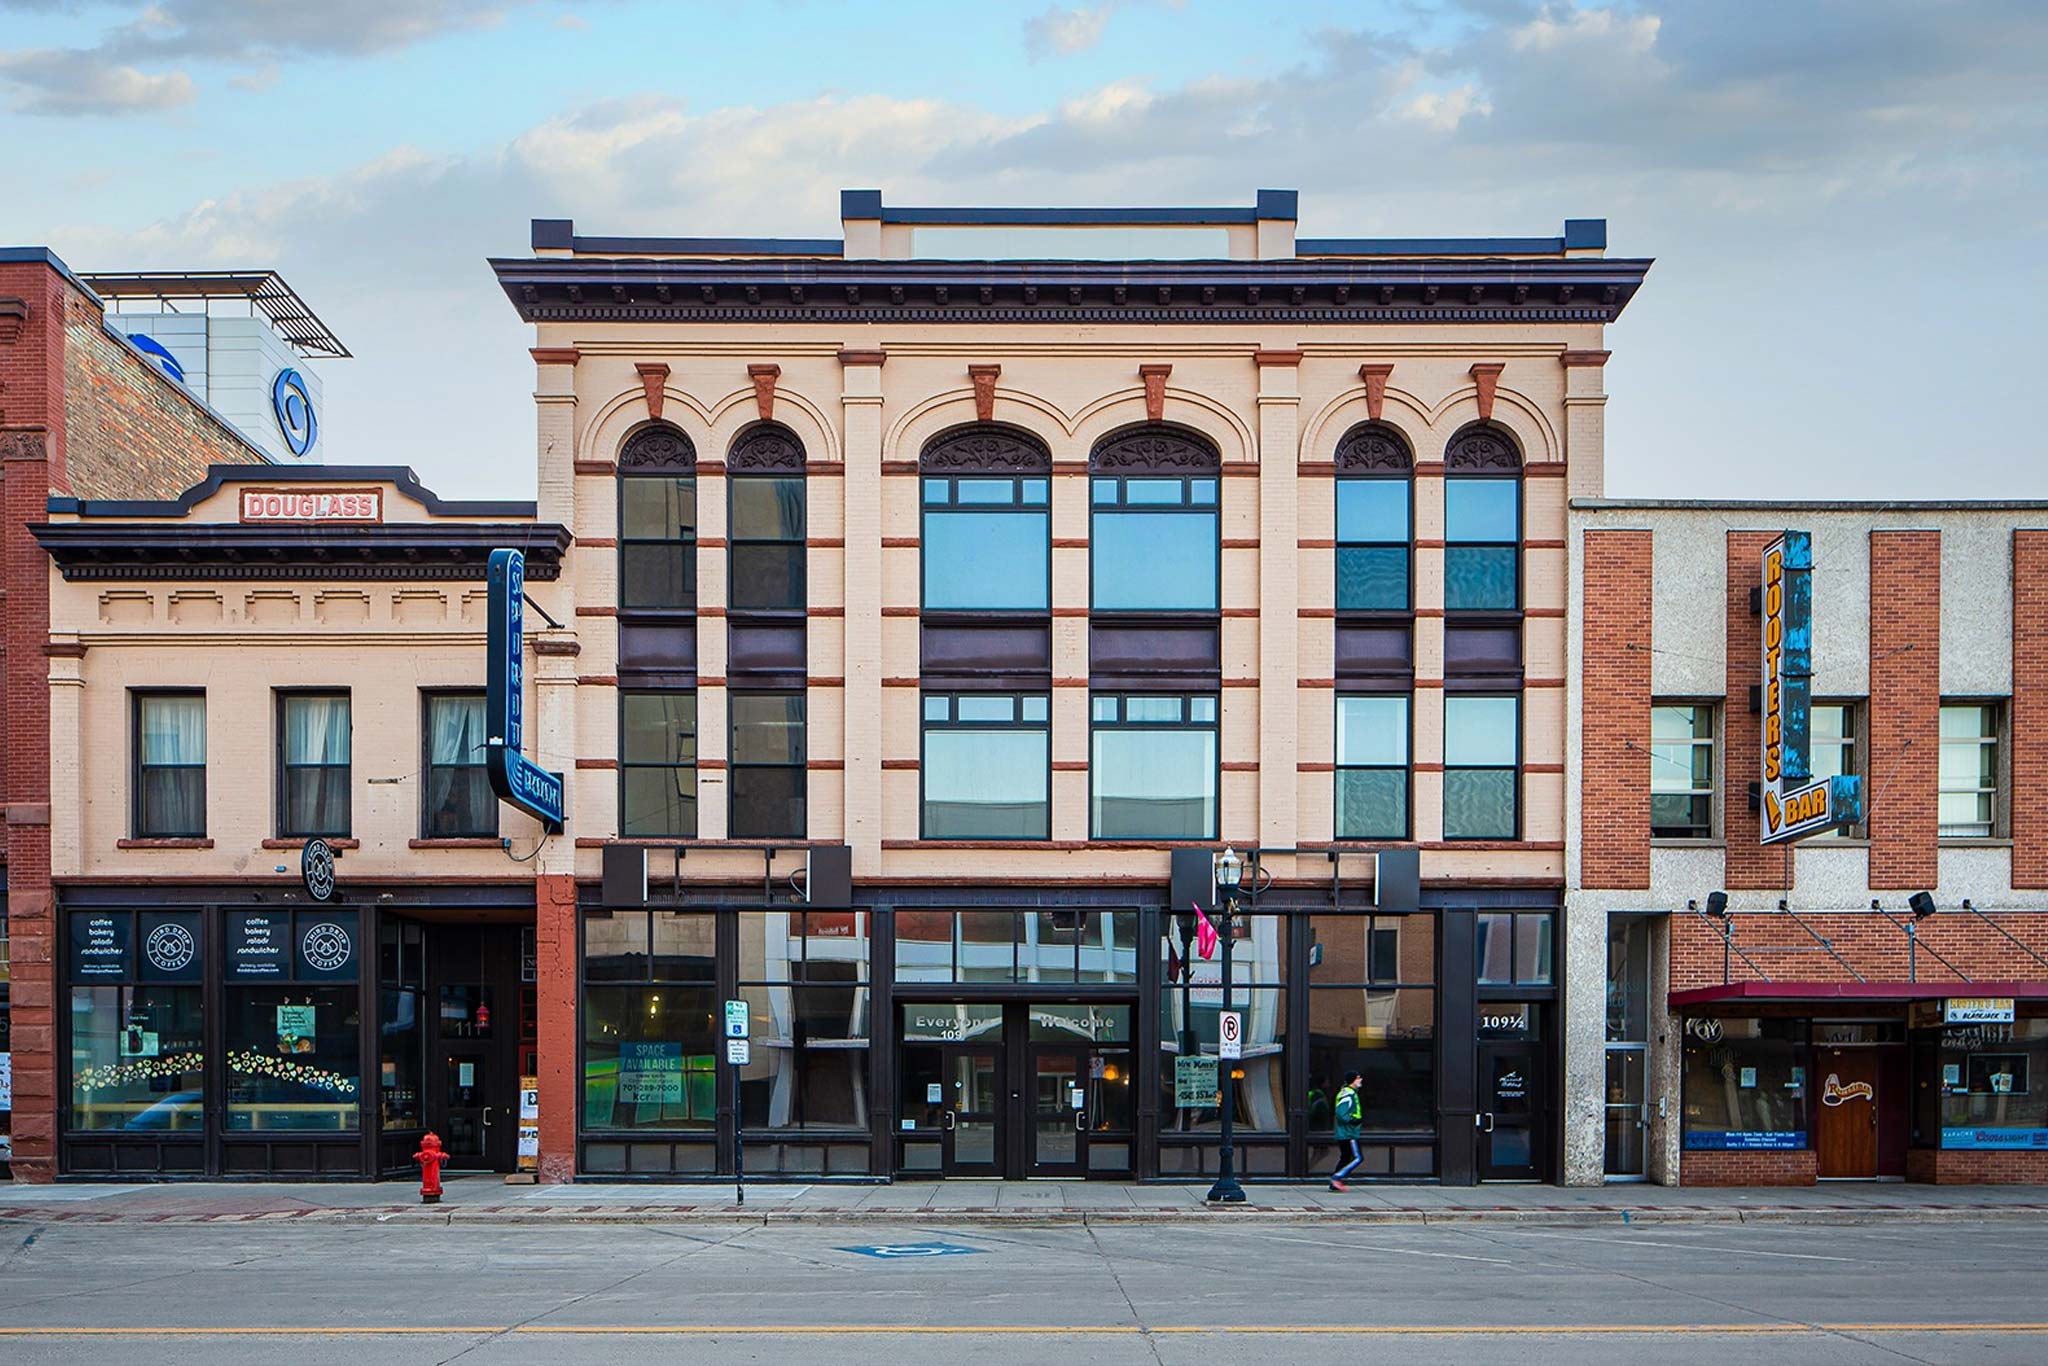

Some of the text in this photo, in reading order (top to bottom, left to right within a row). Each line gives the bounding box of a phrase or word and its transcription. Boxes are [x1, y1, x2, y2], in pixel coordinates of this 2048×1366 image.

[248, 496, 372, 516] DOUGLASS
[1765, 550, 1781, 782] ROOTERS
[1785, 787, 1826, 829] BAR
[90, 918, 113, 927] coffee
[246, 918, 269, 926] coffee
[88, 928, 115, 938] bakery
[150, 926, 191, 945] THIRD DROP
[244, 927, 271, 937] bakery
[307, 926, 347, 945] THIRD DROP
[81, 947, 123, 955] sandwiches
[237, 946, 279, 954] sandwiches
[154, 956, 186, 967] COFFEE
[310, 956, 342, 967] COFFEE
[916, 1015, 1114, 1029] Everyone Welcome
[941, 1030, 962, 1039] 109
[636, 1044, 666, 1057] SPACE
[626, 1058, 676, 1070] AVAILABLE
